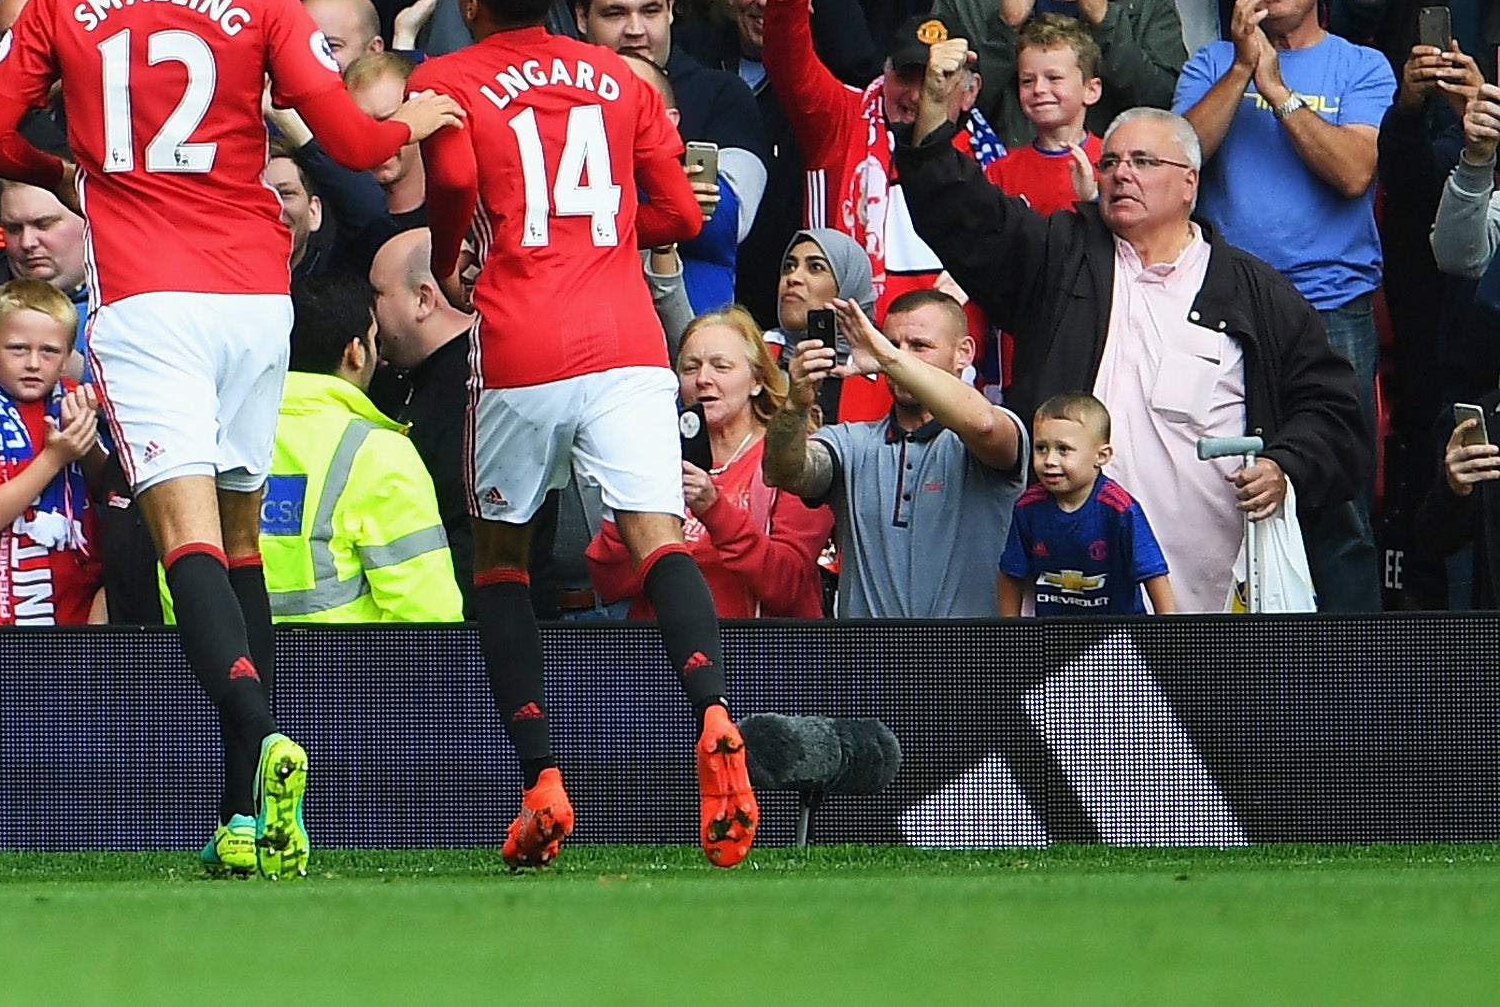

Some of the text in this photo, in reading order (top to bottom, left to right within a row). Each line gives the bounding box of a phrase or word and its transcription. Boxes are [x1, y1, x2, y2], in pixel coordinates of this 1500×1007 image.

[97, 28, 218, 173] 12
[480, 58, 620, 110] LNGARD
[509, 104, 621, 247] 14
[1036, 593, 1110, 607] CHEVROLET
